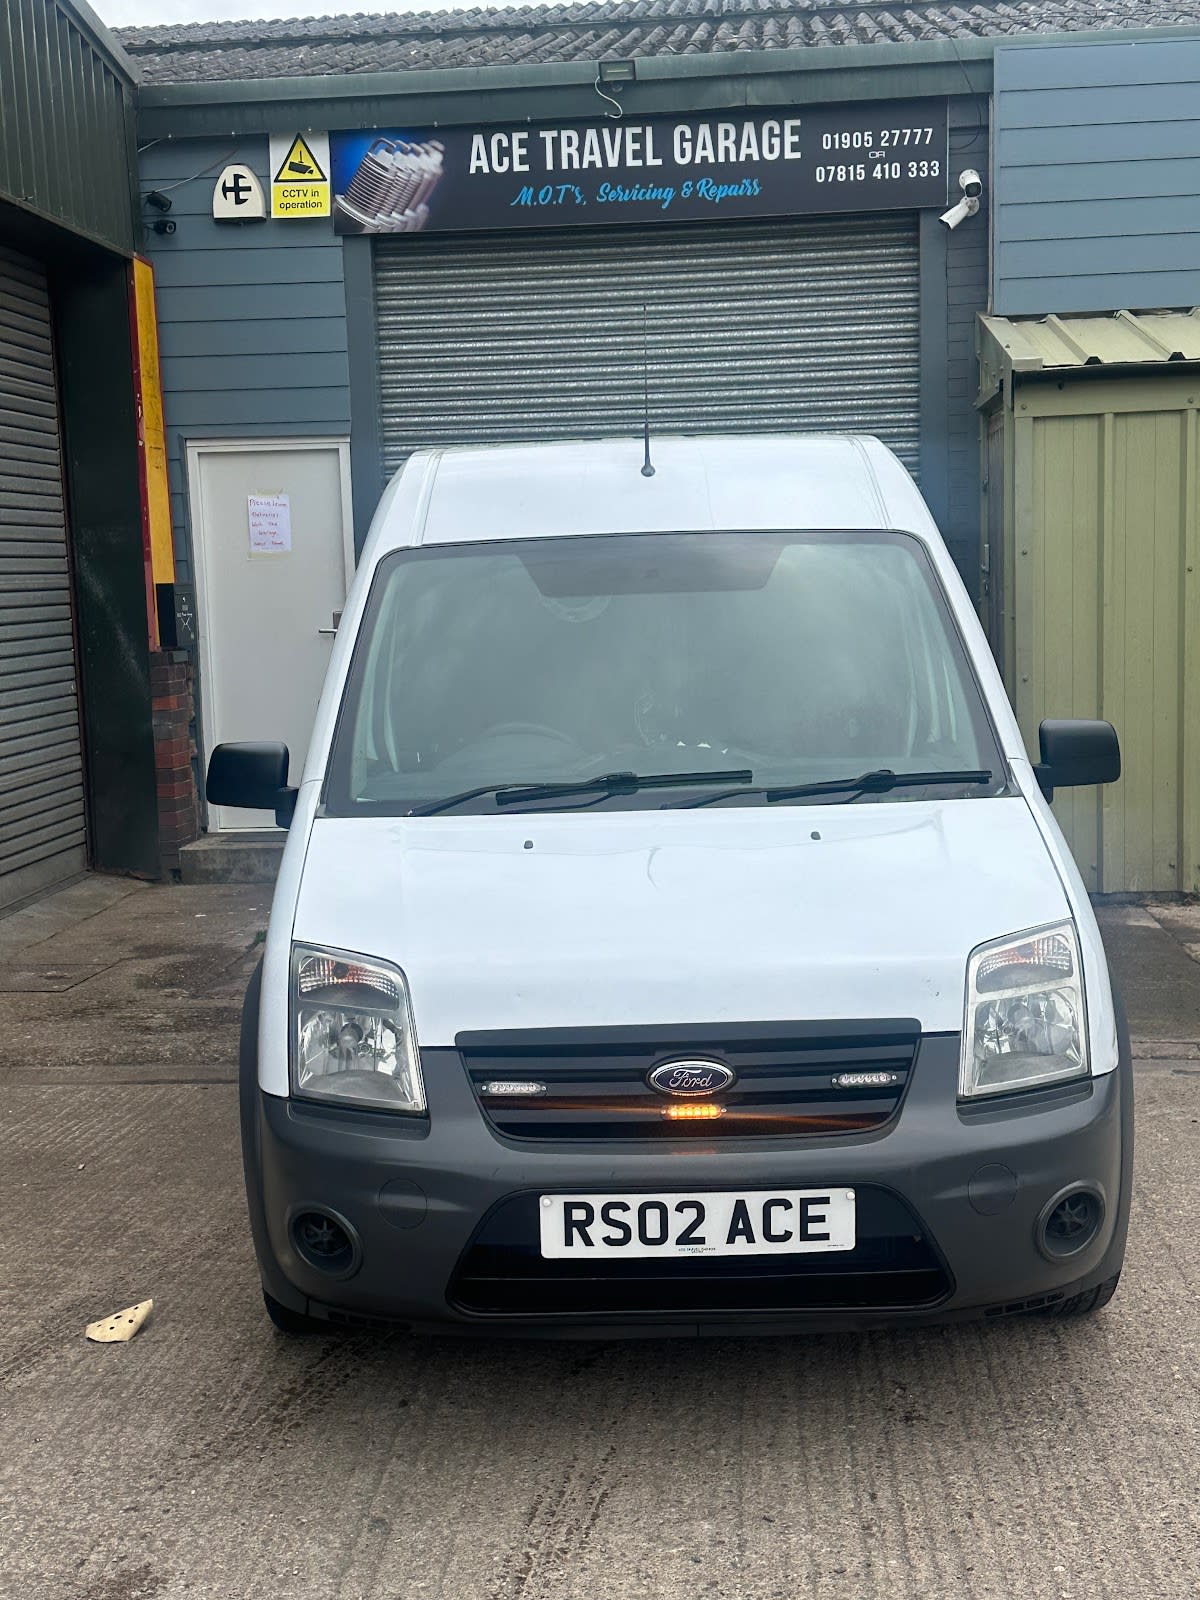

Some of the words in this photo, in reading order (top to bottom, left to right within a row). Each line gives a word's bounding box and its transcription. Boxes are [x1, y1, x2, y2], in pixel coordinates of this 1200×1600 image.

[469, 131, 530, 174] ACE
[539, 126, 663, 170] TRAVEL
[673, 119, 802, 165] GARAGE
[822, 131, 873, 150] 01905
[880, 128, 933, 147] 27777
[868, 151, 886, 159] OR
[815, 164, 866, 183] 07815
[872, 162, 901, 180] 410
[908, 160, 940, 178] 333
[282, 189, 308, 198] CCTV
[311, 189, 320, 198] in
[596, 182, 676, 209] Servicing
[681, 181, 694, 198] &
[697, 177, 762, 204] Repairs
[279, 200, 323, 211] operation
[669, 1068, 713, 1088] Ford
[563, 1200, 706, 1247] RS02
[725, 1196, 831, 1244] ACE
